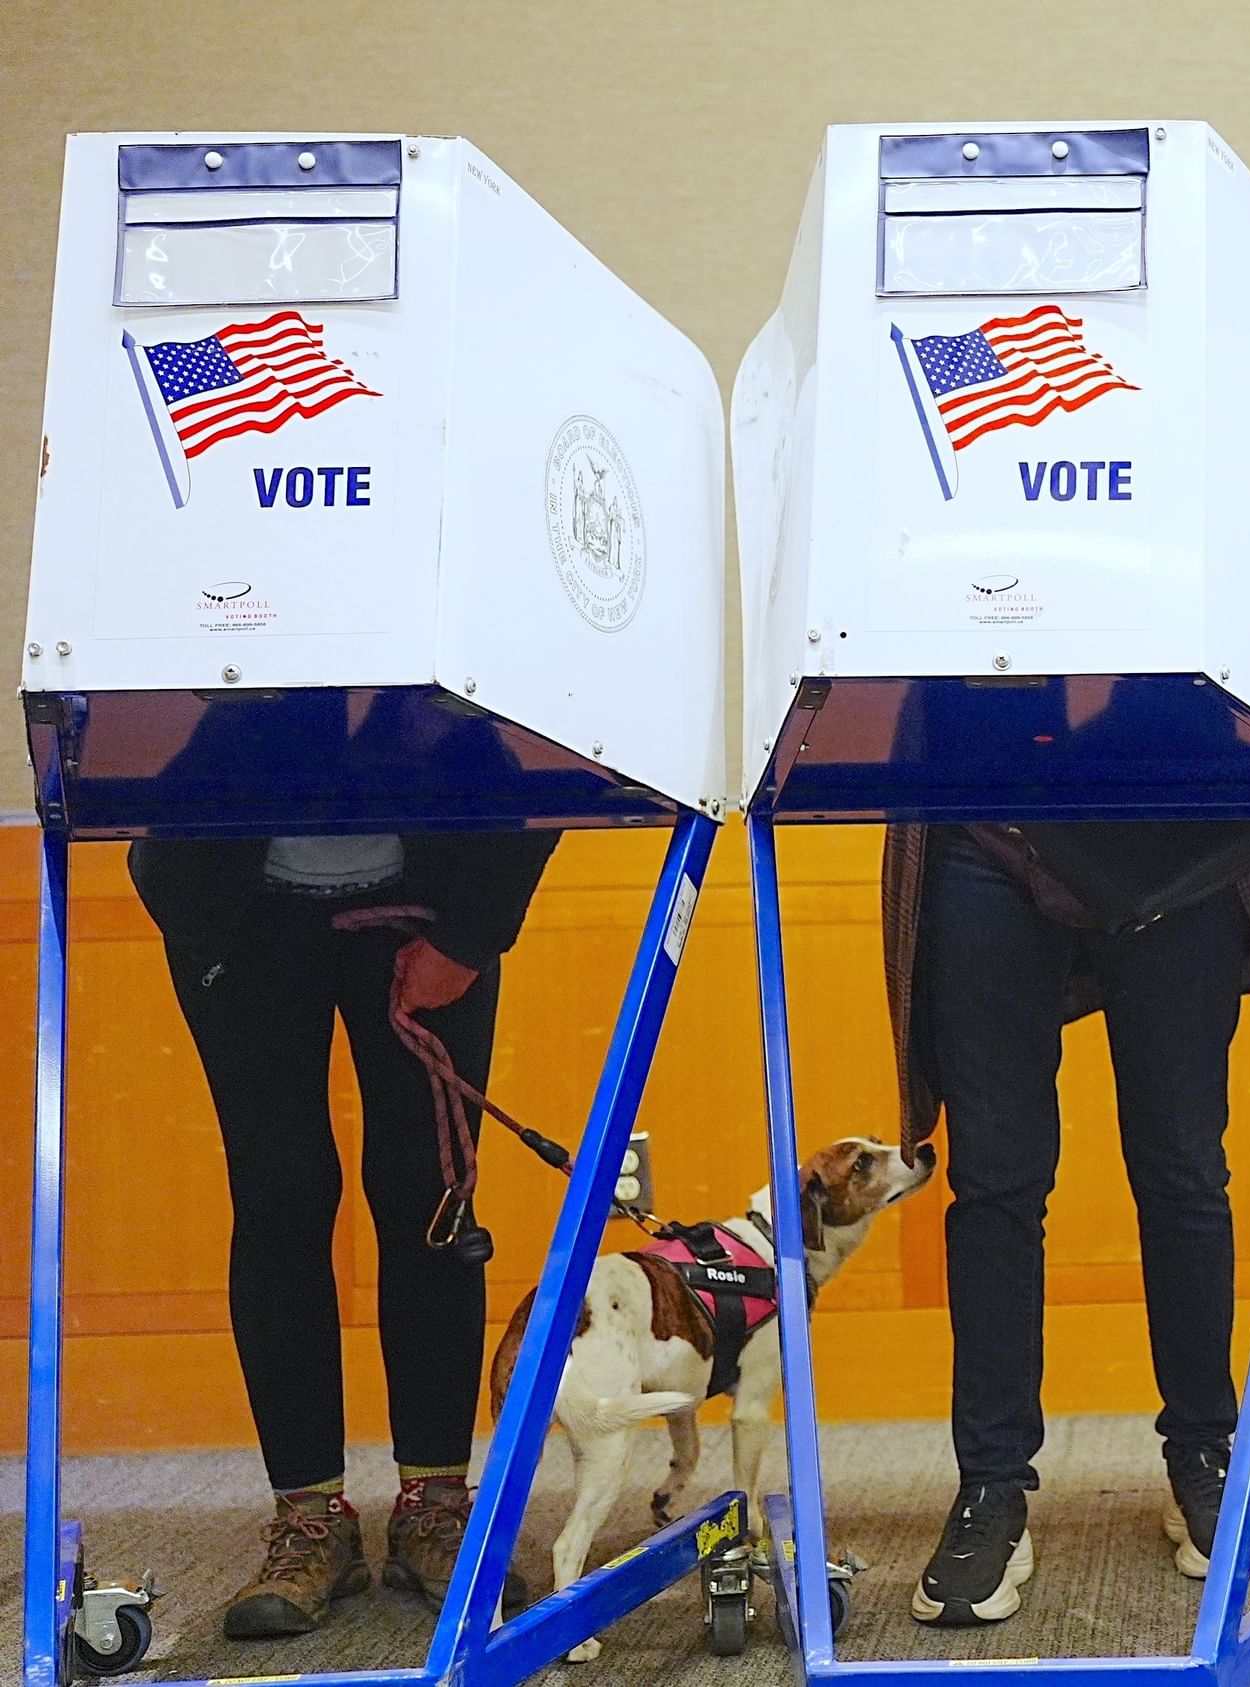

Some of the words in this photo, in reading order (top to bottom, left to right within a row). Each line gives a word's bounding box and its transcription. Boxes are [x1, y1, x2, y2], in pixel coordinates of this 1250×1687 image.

[467, 161, 483, 181] NEW
[483, 173, 501, 196] YORK
[552, 425, 582, 472] BOARD
[582, 424, 596, 441] OF
[253, 467, 370, 508] VOTE
[1019, 461, 1131, 501] VOTE
[196, 601, 271, 610] SMARTPOLL
[565, 570, 590, 609] CITY
[591, 603, 605, 621] OF
[607, 599, 629, 623] NEW
[965, 593, 1037, 602] SMARTPOLL
[707, 1268, 746, 1284] Rosie
